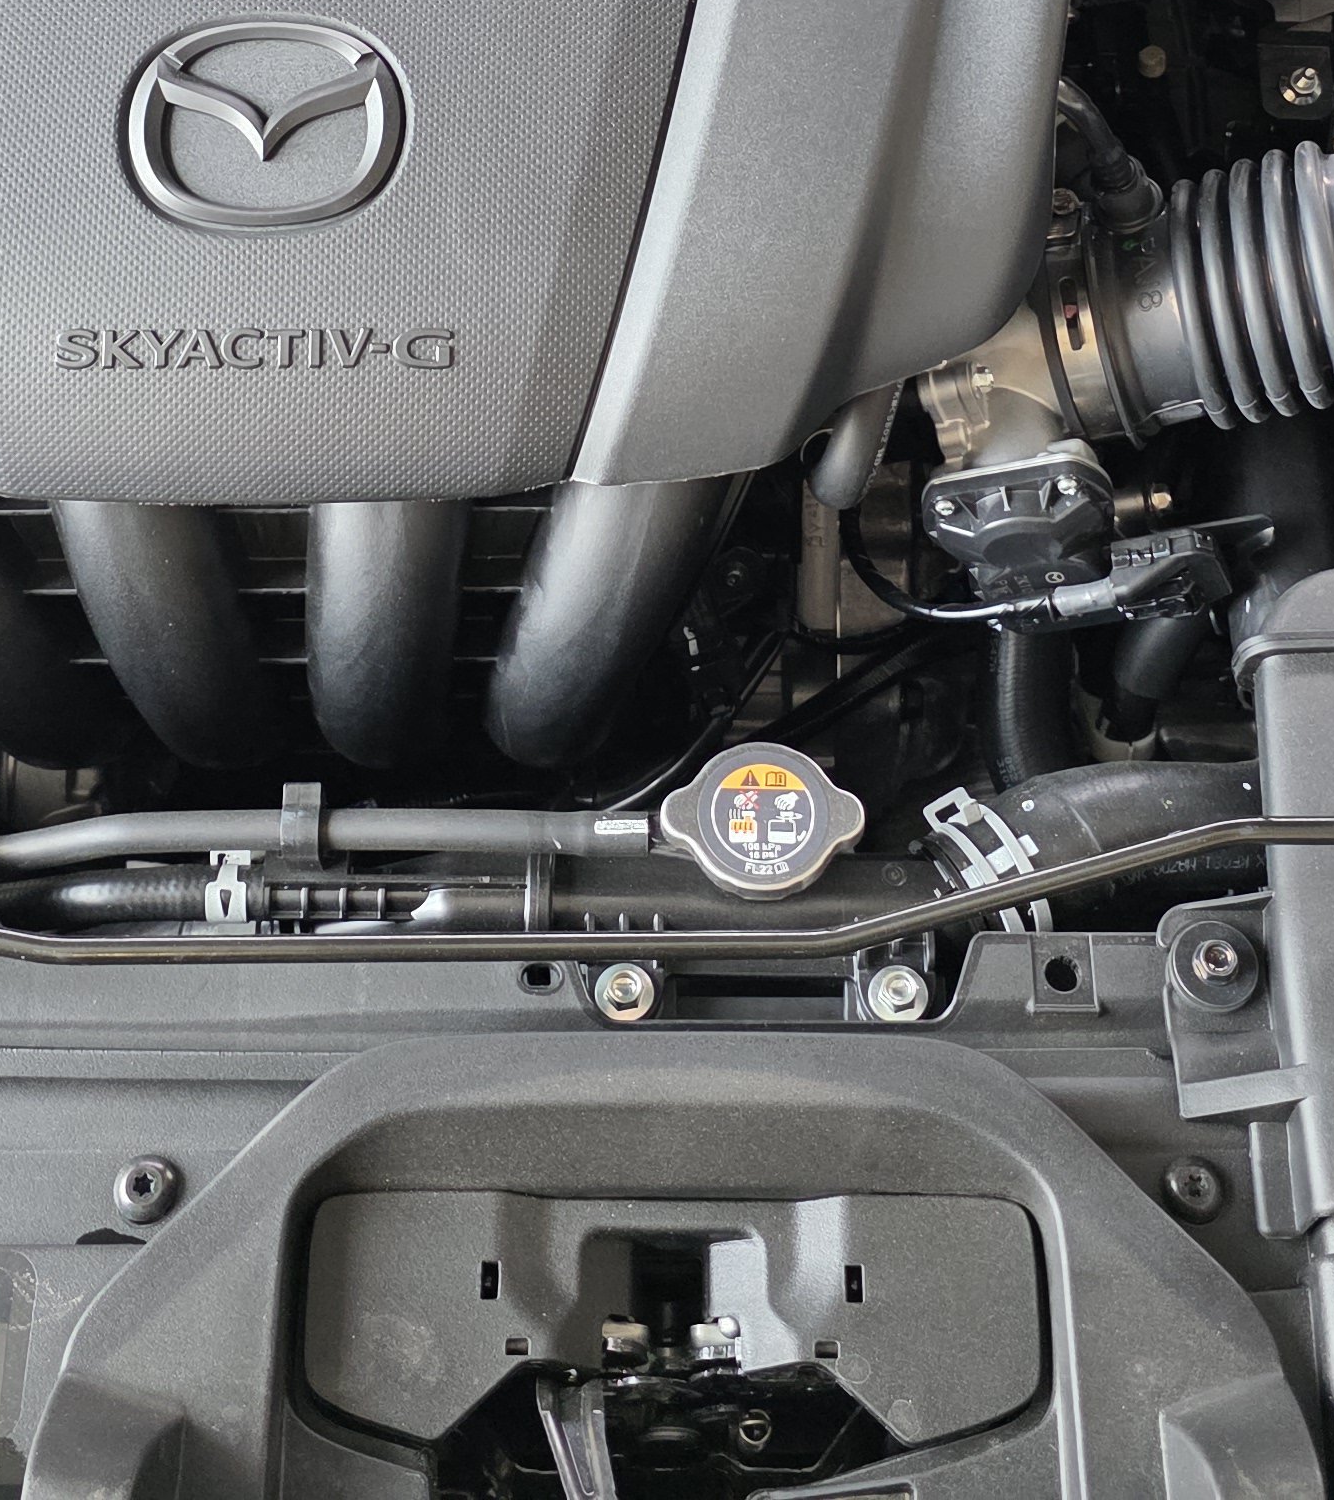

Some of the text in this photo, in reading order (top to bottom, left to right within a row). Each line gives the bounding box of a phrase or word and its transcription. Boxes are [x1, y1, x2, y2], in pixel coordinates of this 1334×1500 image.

[56, 326, 455, 371] SKYACTIV-G
[761, 842, 782, 852] kPa
[744, 861, 774, 875] FL22
